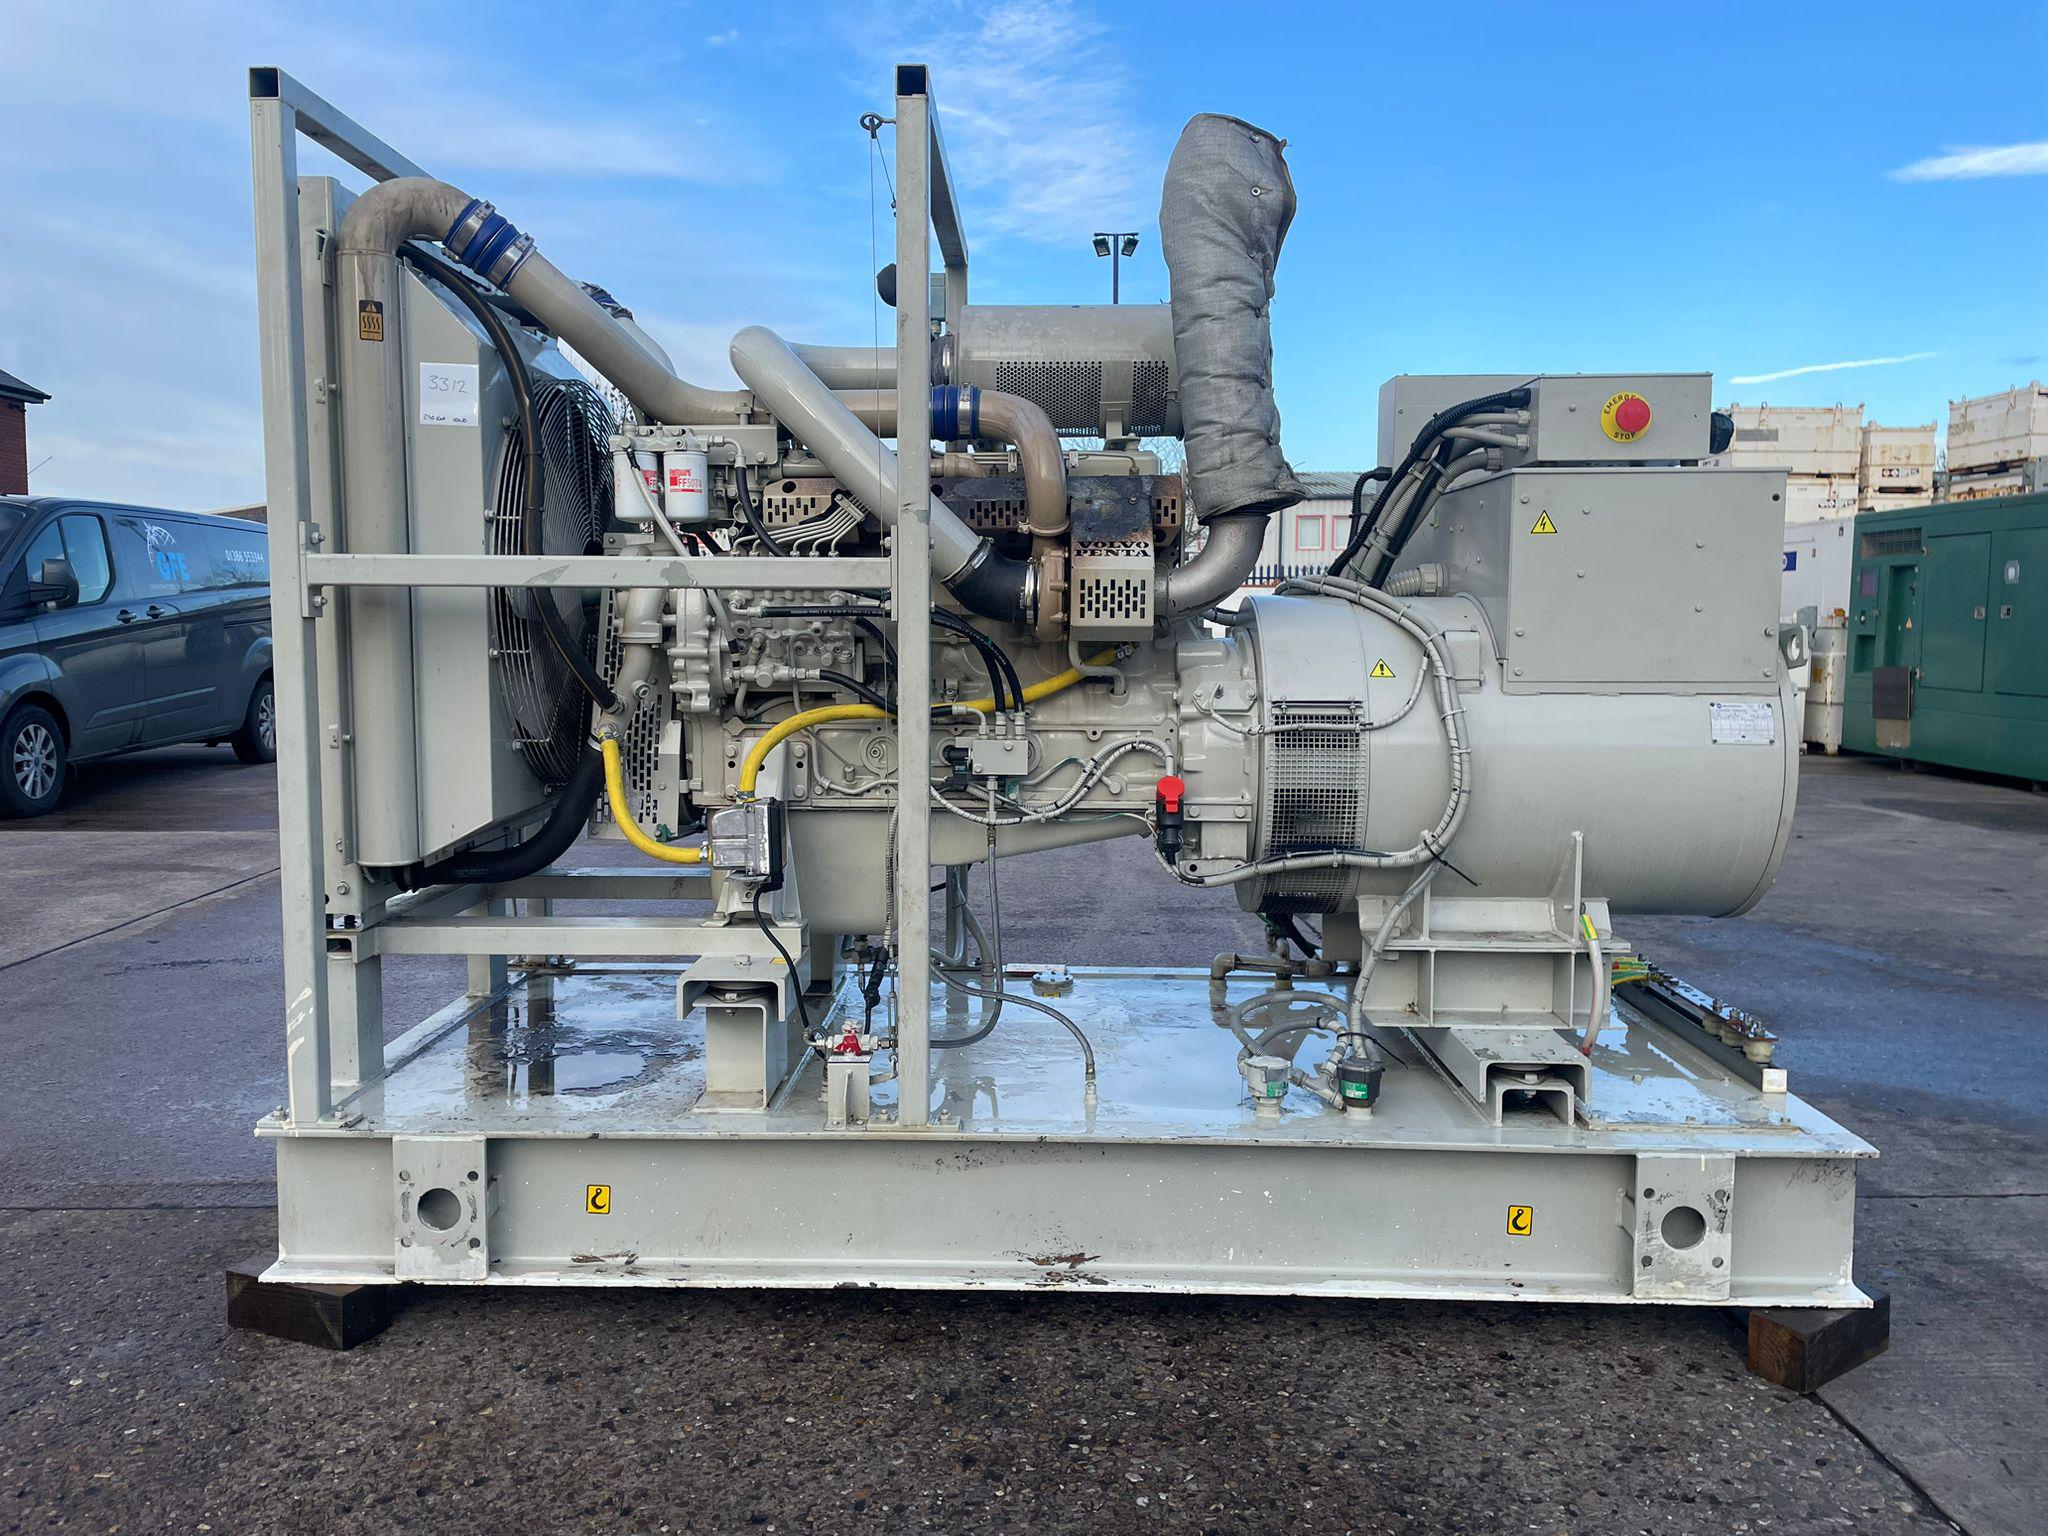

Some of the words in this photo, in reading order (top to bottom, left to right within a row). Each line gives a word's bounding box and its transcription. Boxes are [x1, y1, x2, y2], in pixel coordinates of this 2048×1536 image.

[428, 375, 468, 394] 3312
[1613, 431, 1636, 440] STOP
[1074, 549, 1151, 557] PENTA
[156, 551, 191, 581] GFE
